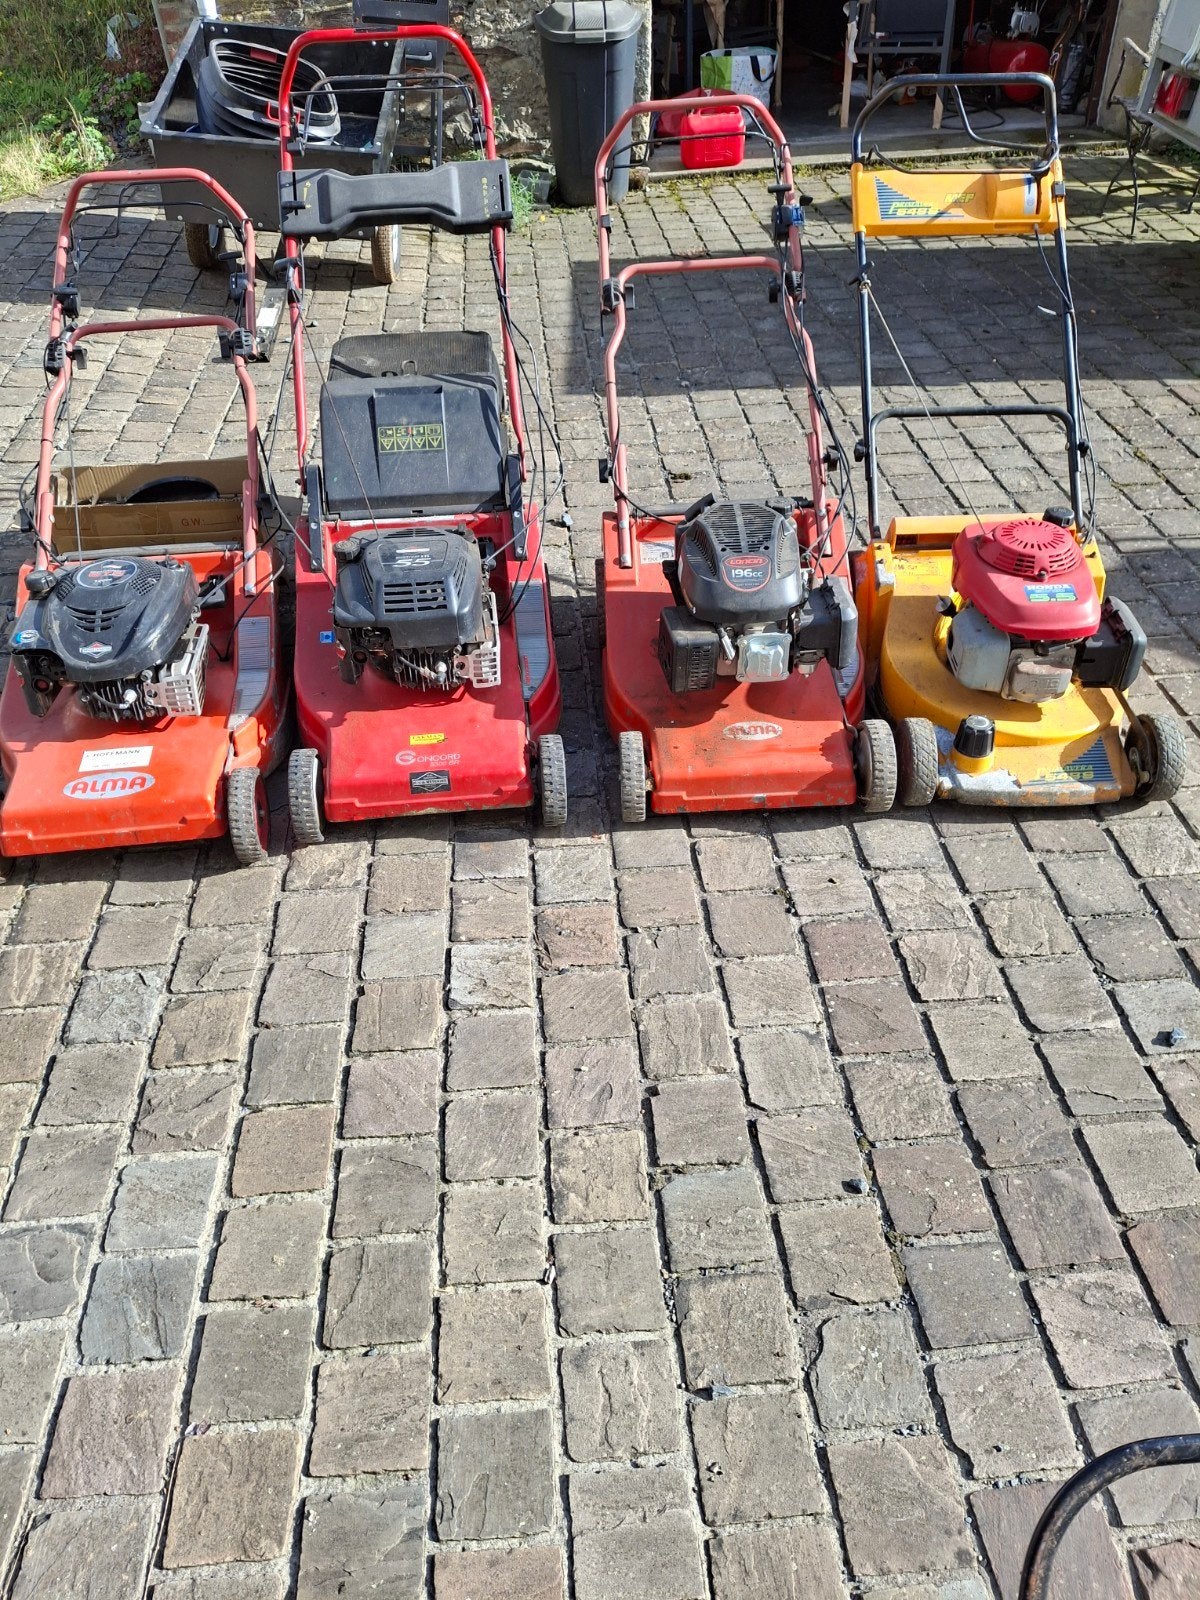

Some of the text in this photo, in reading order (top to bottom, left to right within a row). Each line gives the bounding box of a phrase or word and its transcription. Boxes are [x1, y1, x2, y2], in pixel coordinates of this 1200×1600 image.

[392, 558, 431, 567] 55
[731, 569, 763, 578] 196cc
[395, 749, 461, 766] CONCORD
[70, 776, 146, 795] ALMA
